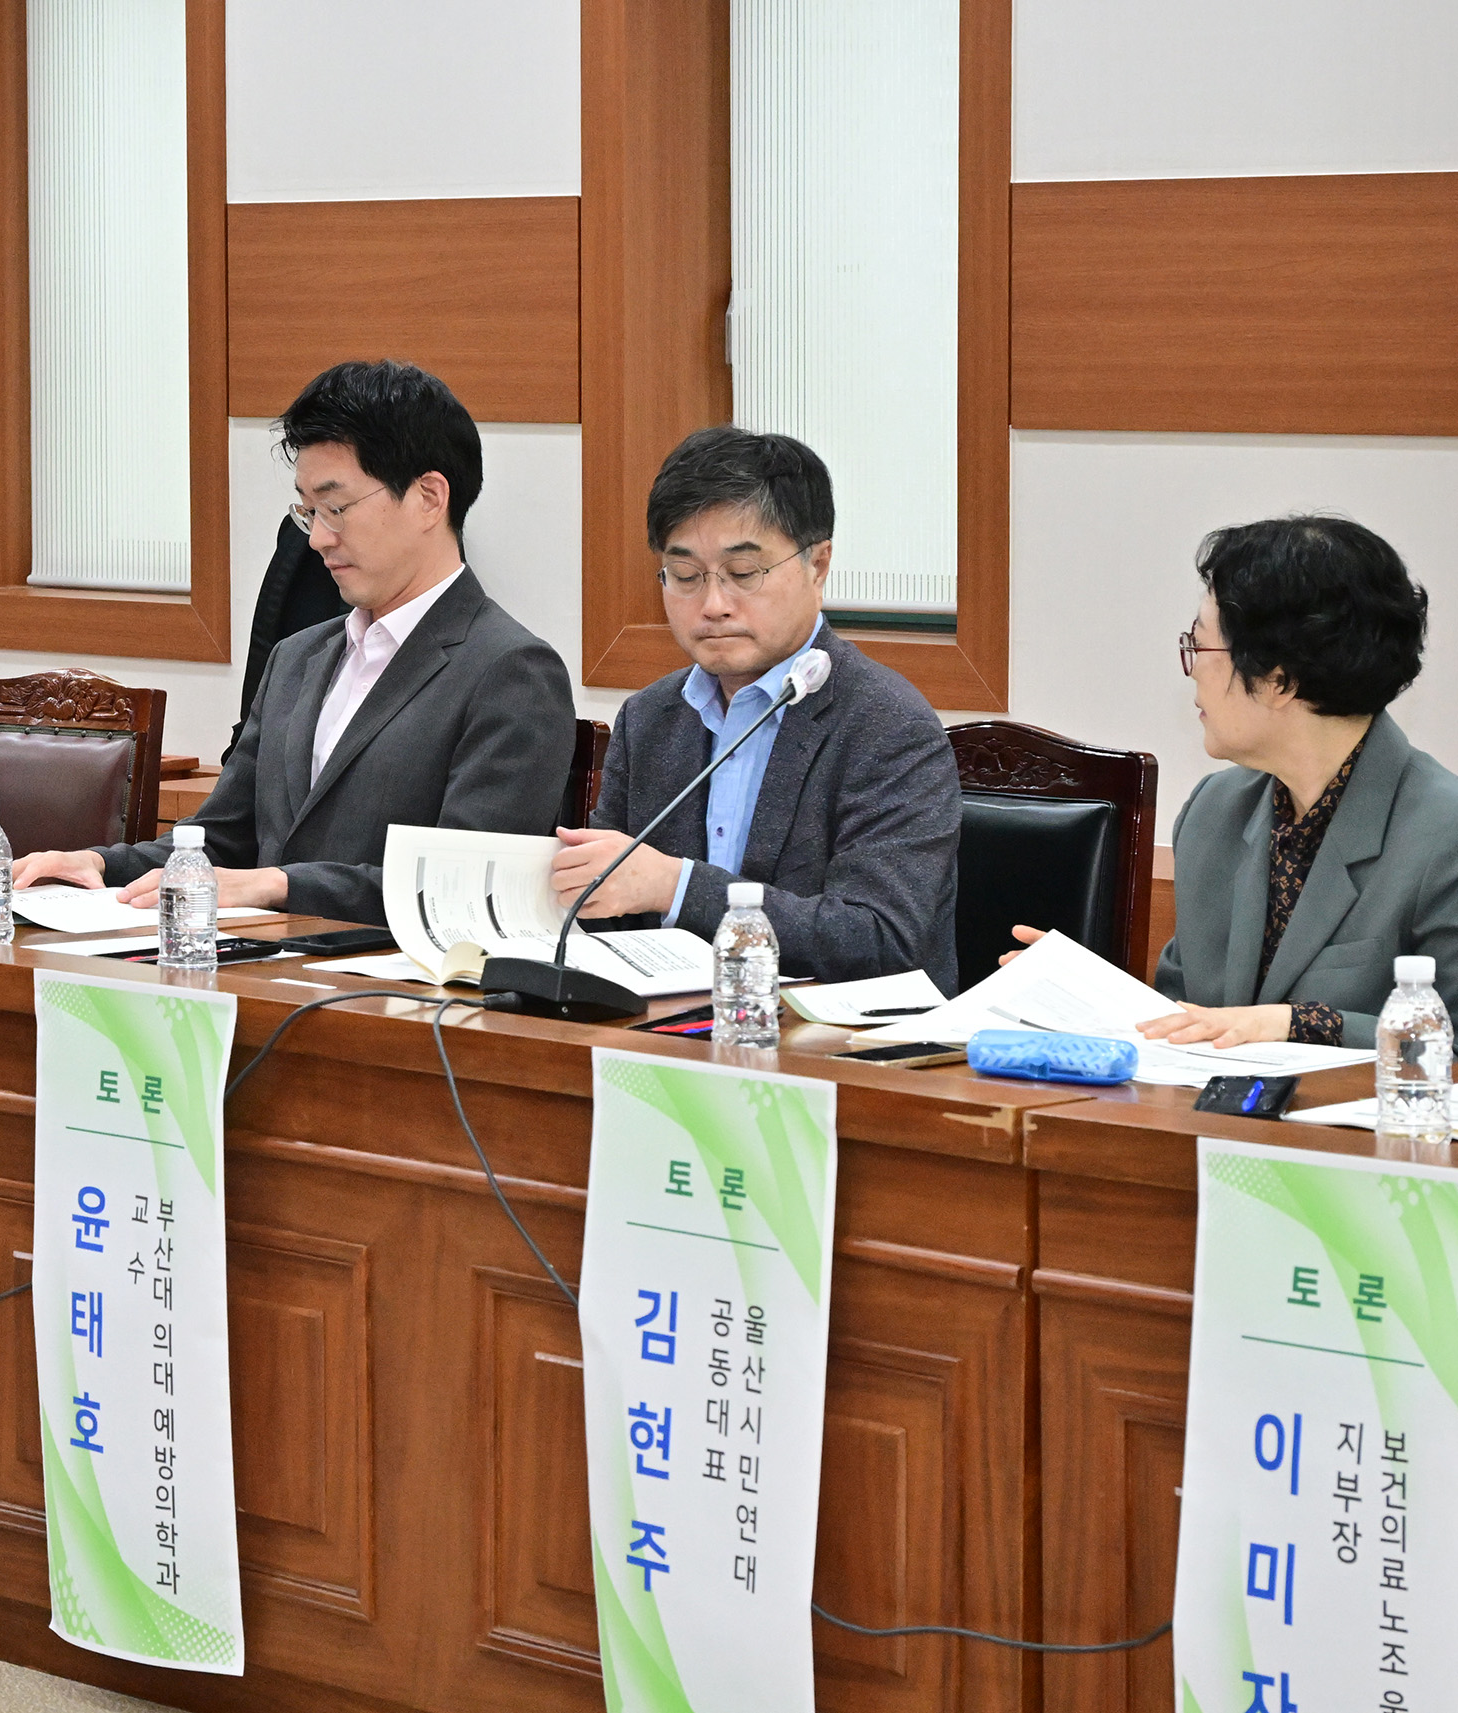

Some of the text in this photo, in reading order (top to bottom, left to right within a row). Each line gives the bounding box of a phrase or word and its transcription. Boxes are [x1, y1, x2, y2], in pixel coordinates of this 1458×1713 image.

[96, 1070, 164, 1115] 토론
[665, 1160, 747, 1211] 토론
[69, 1186, 110, 1454] 윤태호
[1287, 1266, 1388, 1323] 토론
[153, 1198, 181, 1595] 부산대 의대 예방의학과
[626, 1289, 681, 1593] 김현주
[702, 1298, 734, 1482] 공동대표
[734, 1305, 767, 1594] 울산시민연대
[1332, 1423, 1364, 1564] 지부장
